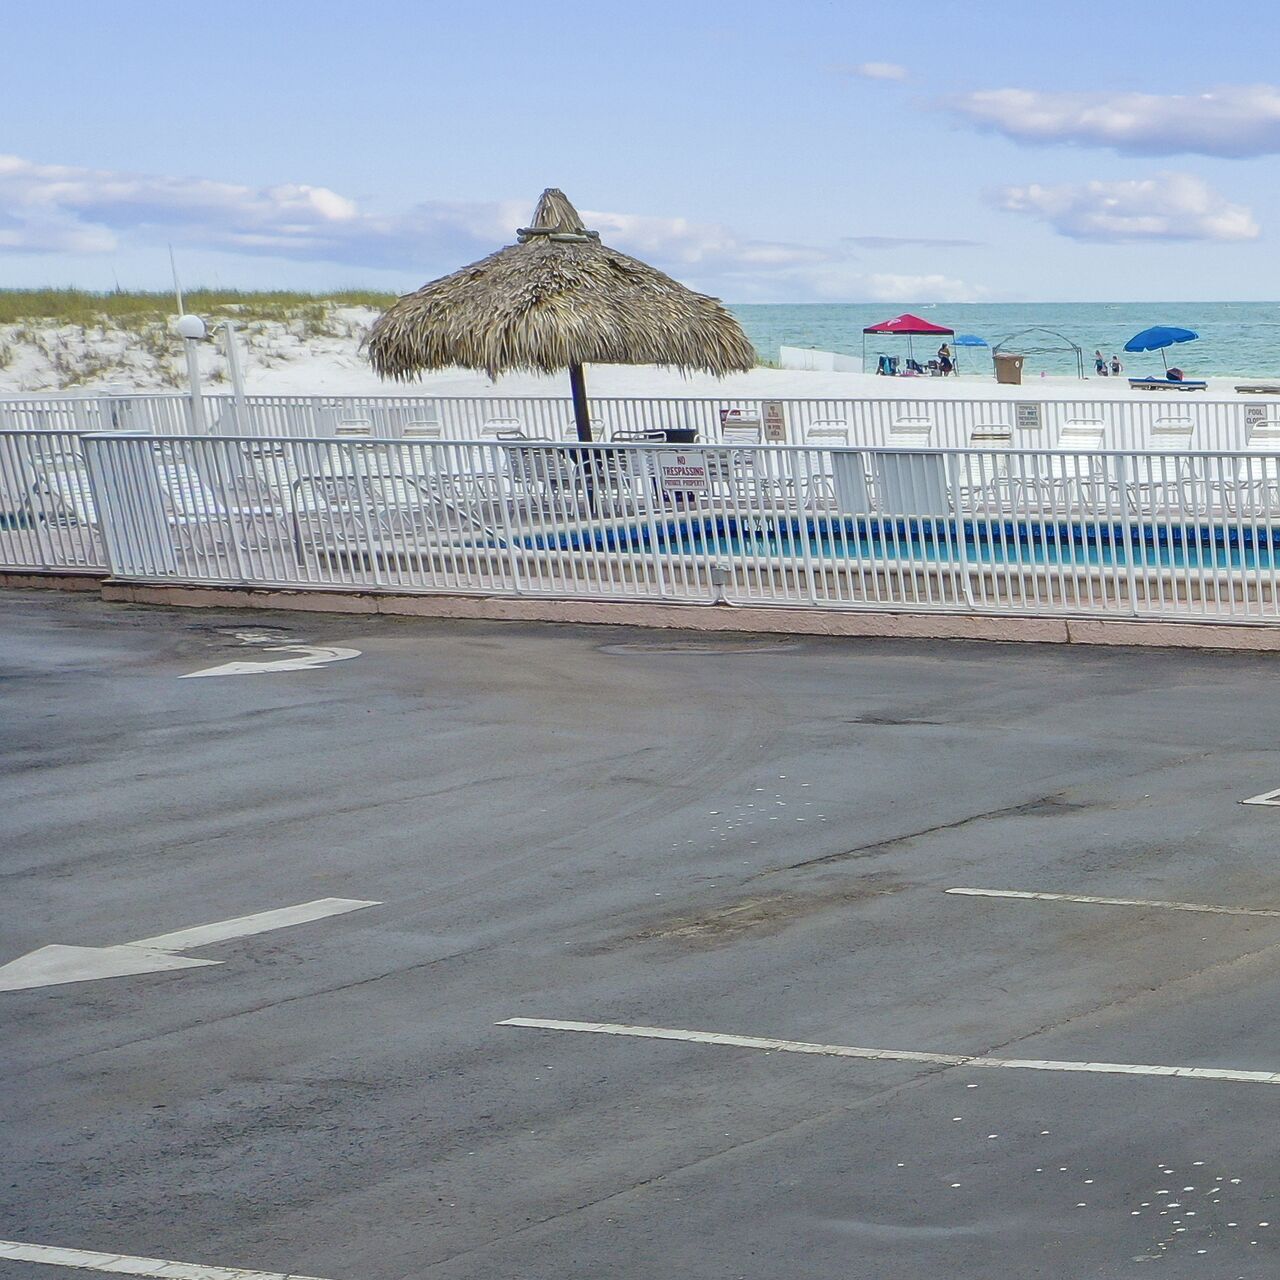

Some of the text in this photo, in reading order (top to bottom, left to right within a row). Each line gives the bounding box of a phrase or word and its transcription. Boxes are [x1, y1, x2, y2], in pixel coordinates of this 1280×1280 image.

[1247, 408, 1263, 416] POOL
[676, 455, 686, 465] NO
[662, 466, 705, 476] TRESPASSING
[682, 479, 705, 487] PROPERTY
